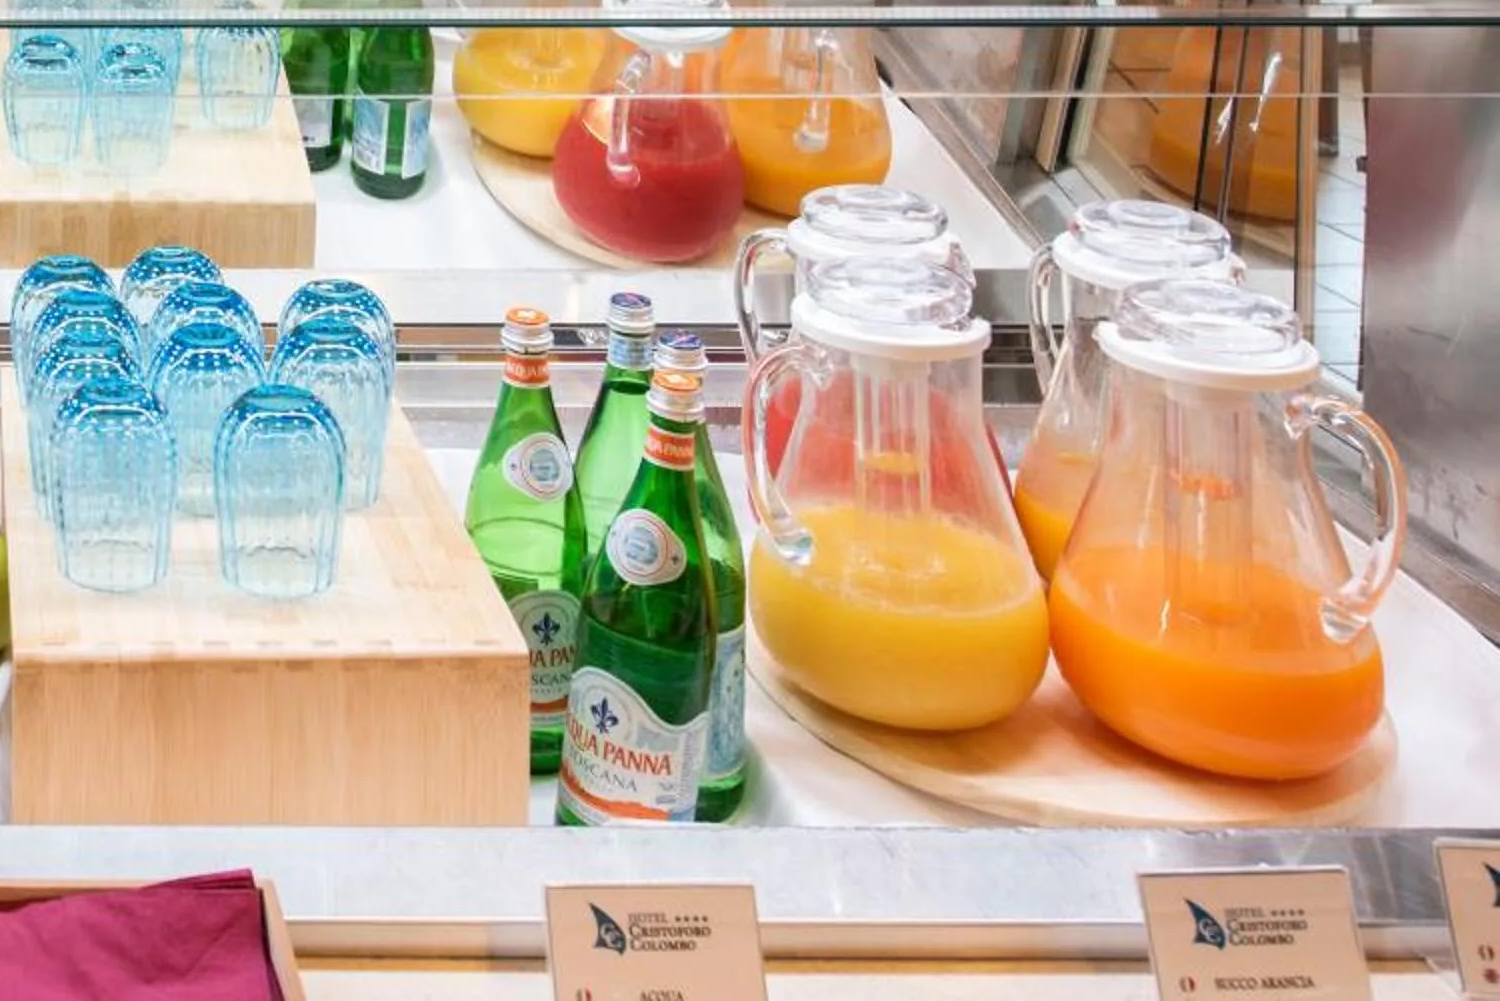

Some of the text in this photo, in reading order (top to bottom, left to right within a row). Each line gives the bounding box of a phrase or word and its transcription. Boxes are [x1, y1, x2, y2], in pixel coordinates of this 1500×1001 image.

[603, 739, 673, 776] PANNA
[628, 912, 668, 923] HOTEL
[1224, 906, 1264, 918] HOTEL
[628, 923, 712, 939] CRISTOFORO
[1226, 919, 1308, 933] CRISTOFORO
[629, 939, 698, 951] COLOMBO
[1228, 933, 1295, 947] COLOMBO
[1260, 974, 1316, 990] ARANCIA
